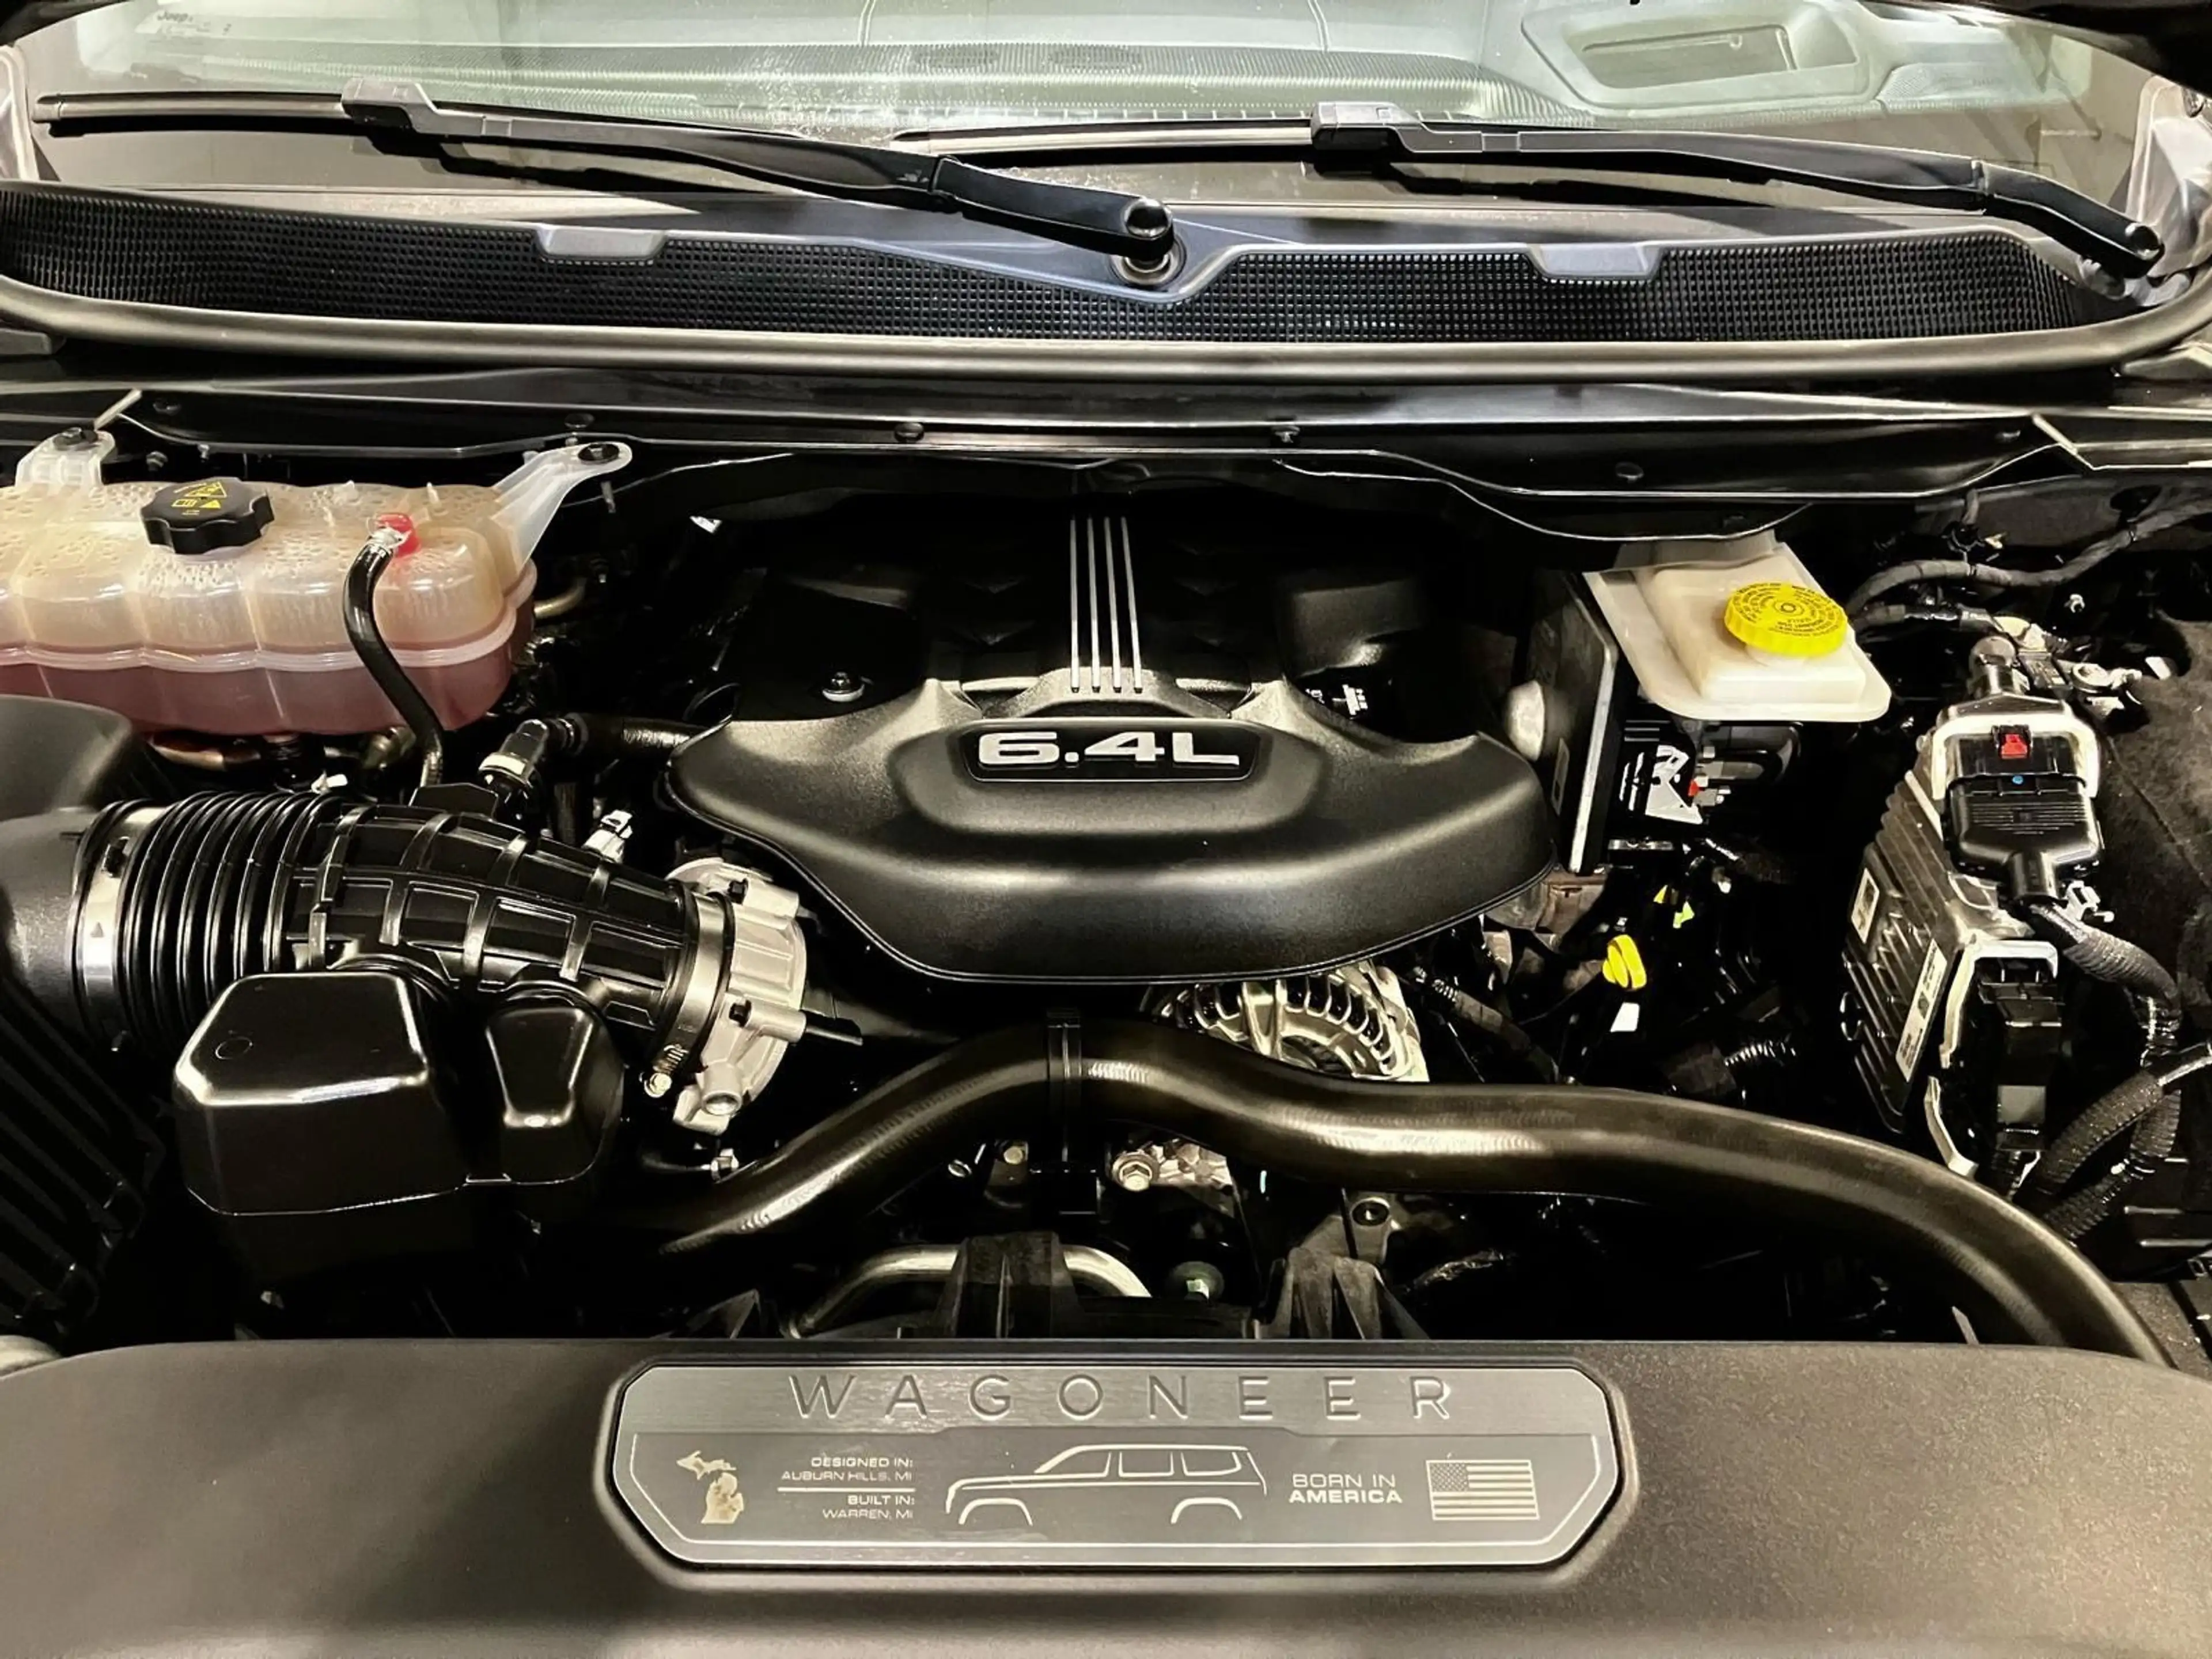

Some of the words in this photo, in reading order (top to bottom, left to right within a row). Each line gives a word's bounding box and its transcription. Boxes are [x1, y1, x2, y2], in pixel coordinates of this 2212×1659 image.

[979, 731, 1240, 767] 6.4L
[787, 1373, 1450, 1421] WAGONEER
[810, 1457, 890, 1468] DESIGNED
[894, 1457, 914, 1468] IN:
[781, 1470, 845, 1481] AUBURN
[895, 1471, 912, 1481] MI
[1292, 1473, 1363, 1488] BORN
[1372, 1473, 1396, 1488] IN
[847, 1495, 892, 1505] BUILT
[895, 1495, 915, 1505] IN:
[1288, 1488, 1403, 1503] AMERICA
[822, 1509, 893, 1520] WARREN,
[895, 1509, 914, 1519] MI
